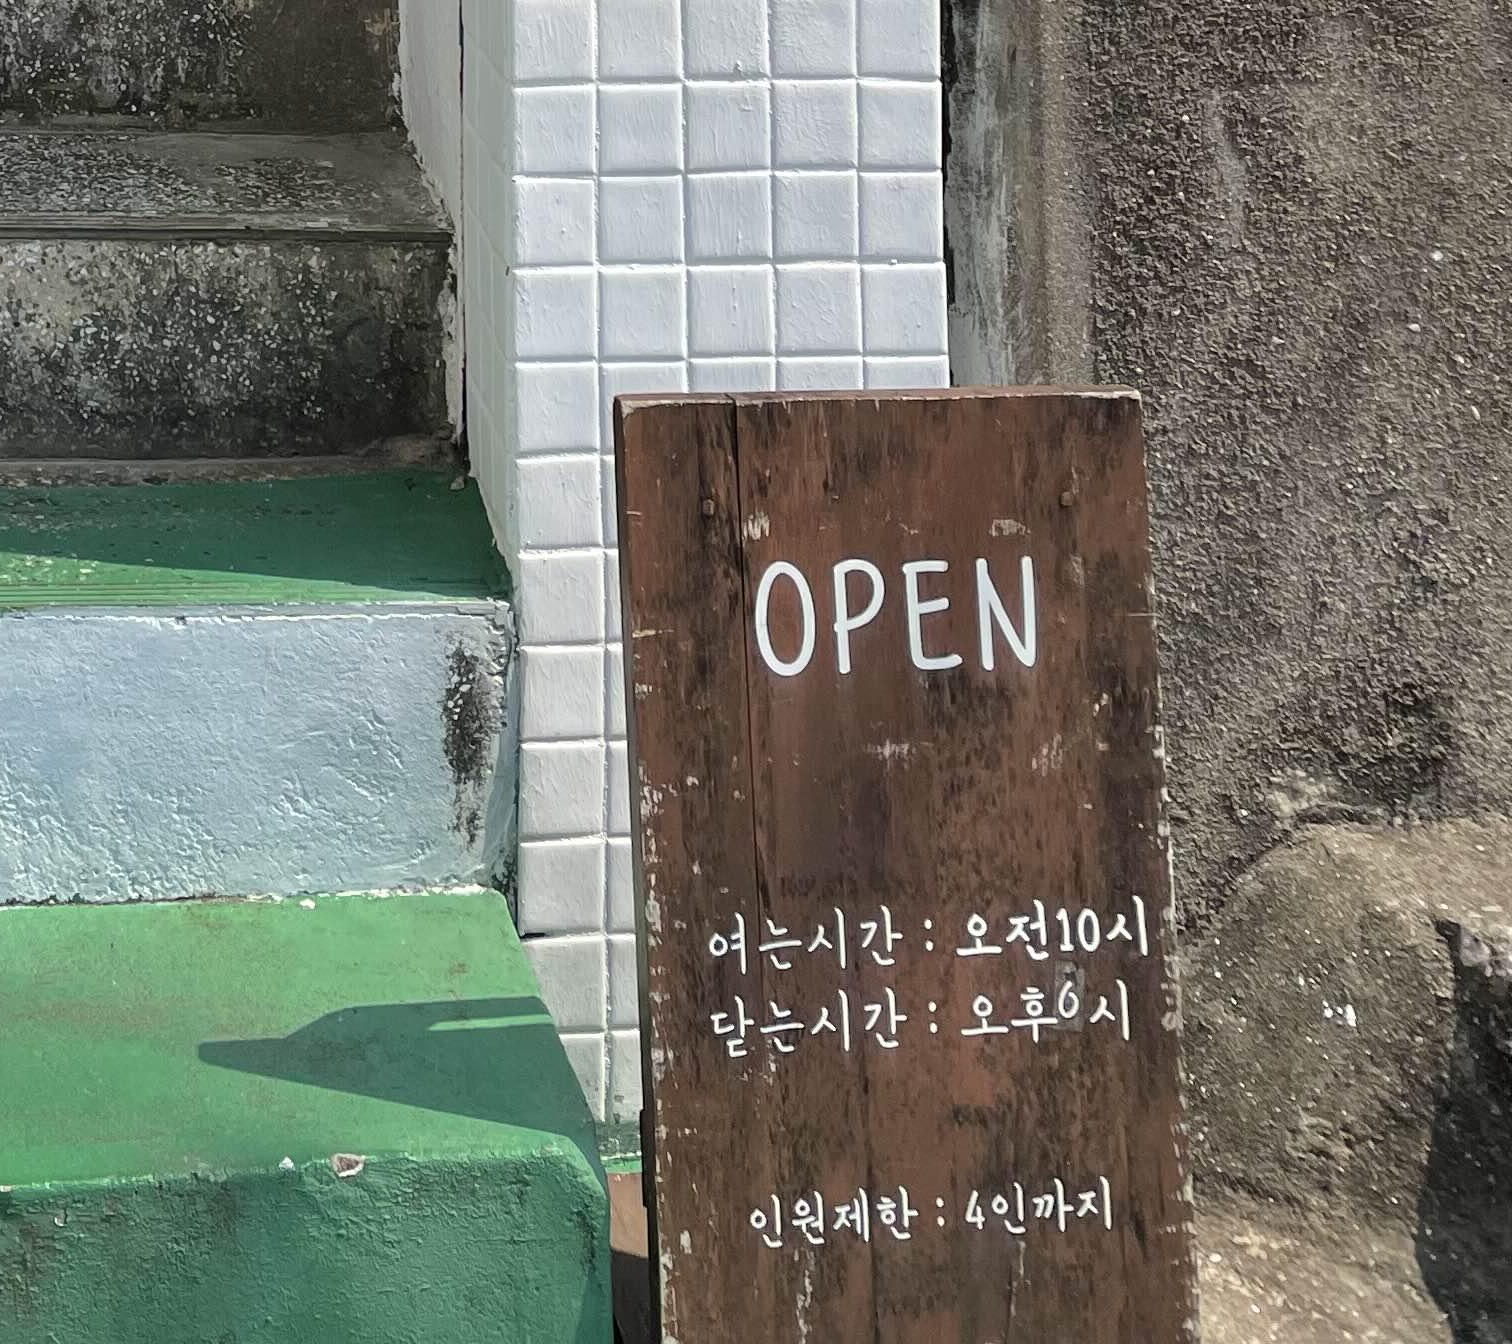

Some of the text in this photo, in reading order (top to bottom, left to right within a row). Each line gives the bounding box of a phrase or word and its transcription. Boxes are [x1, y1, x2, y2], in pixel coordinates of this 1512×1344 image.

[754, 554, 1038, 678] OPEN
[709, 905, 903, 975] 여는시간
[956, 895, 1149, 960] 오전10시
[710, 986, 907, 1058] 닫는시간
[749, 1185, 919, 1249] 인원제한
[964, 1175, 1113, 1235] 4인까지
